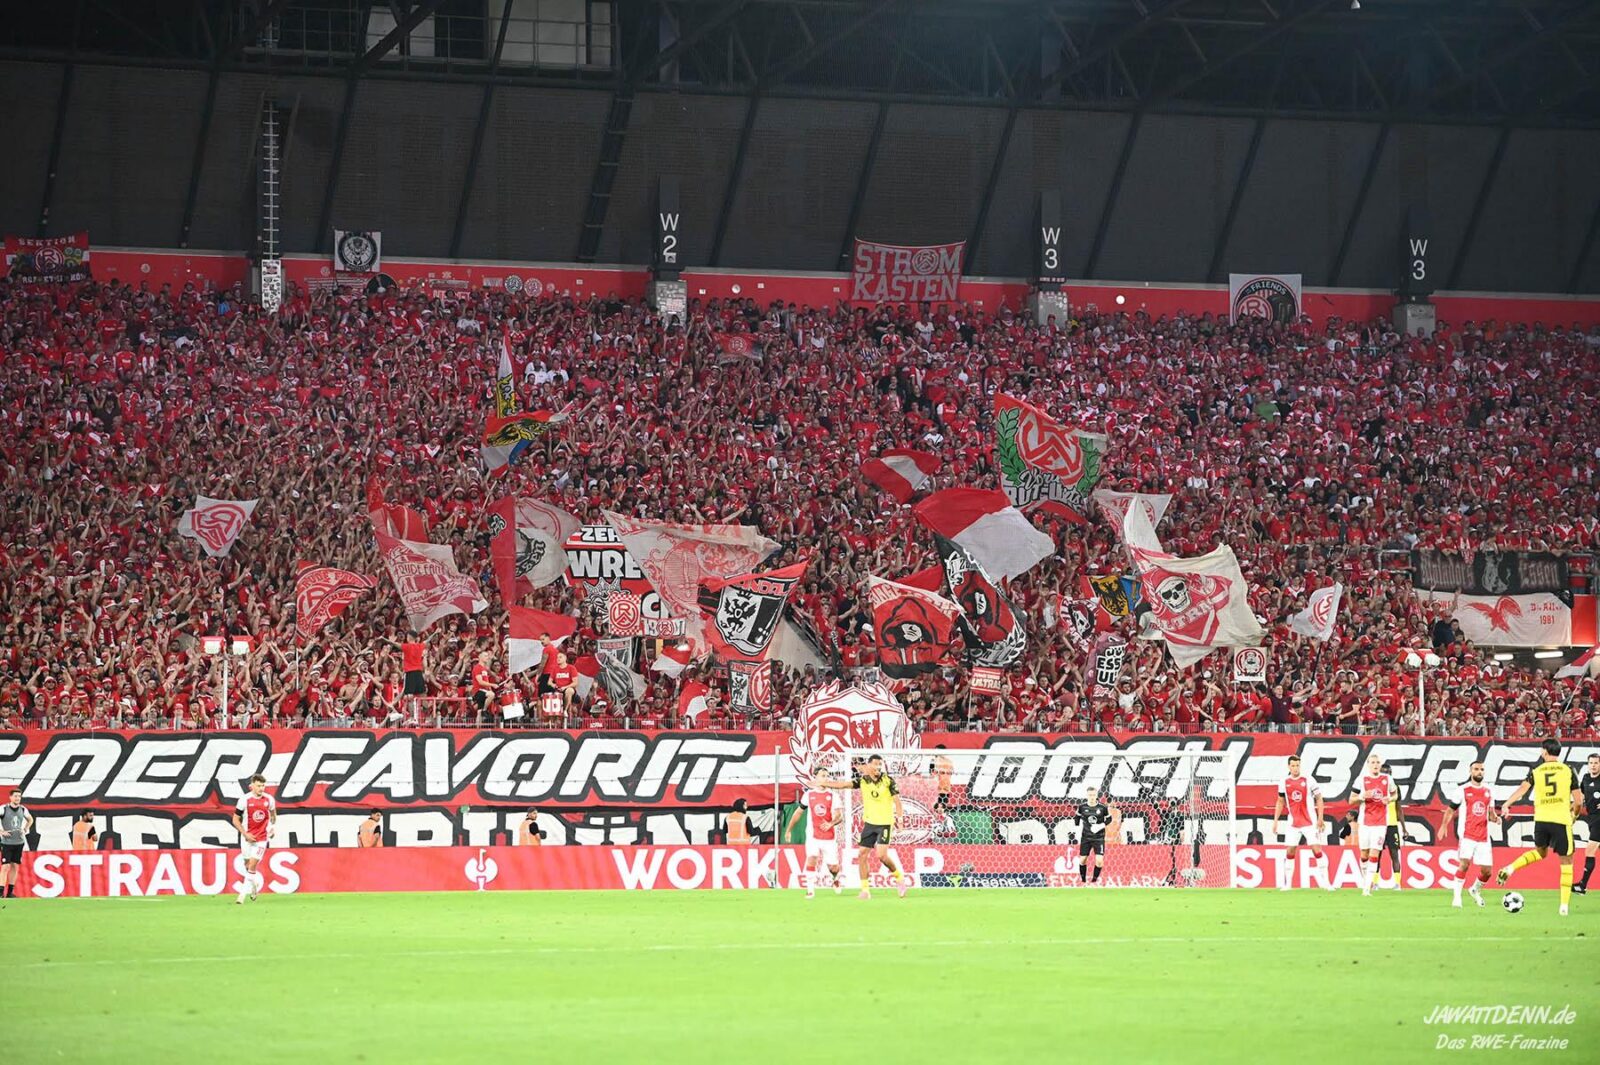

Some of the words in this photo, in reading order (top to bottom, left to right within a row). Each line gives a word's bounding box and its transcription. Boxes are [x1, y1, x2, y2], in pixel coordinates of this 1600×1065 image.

[660, 213, 679, 231] W
[663, 235, 677, 256] 2
[1042, 227, 1060, 244] W
[1410, 239, 1427, 256] W
[1045, 248, 1058, 269] 3
[1413, 260, 1425, 280] 3
[852, 272, 960, 301] KASTEN
[1250, 281, 1287, 296] FRIENDS
[18, 737, 269, 800] DER
[281, 736, 752, 800] FAVORIT
[968, 740, 1252, 799] DOCH
[1545, 773, 1557, 796] 5
[32, 853, 300, 897] STRAUSS
